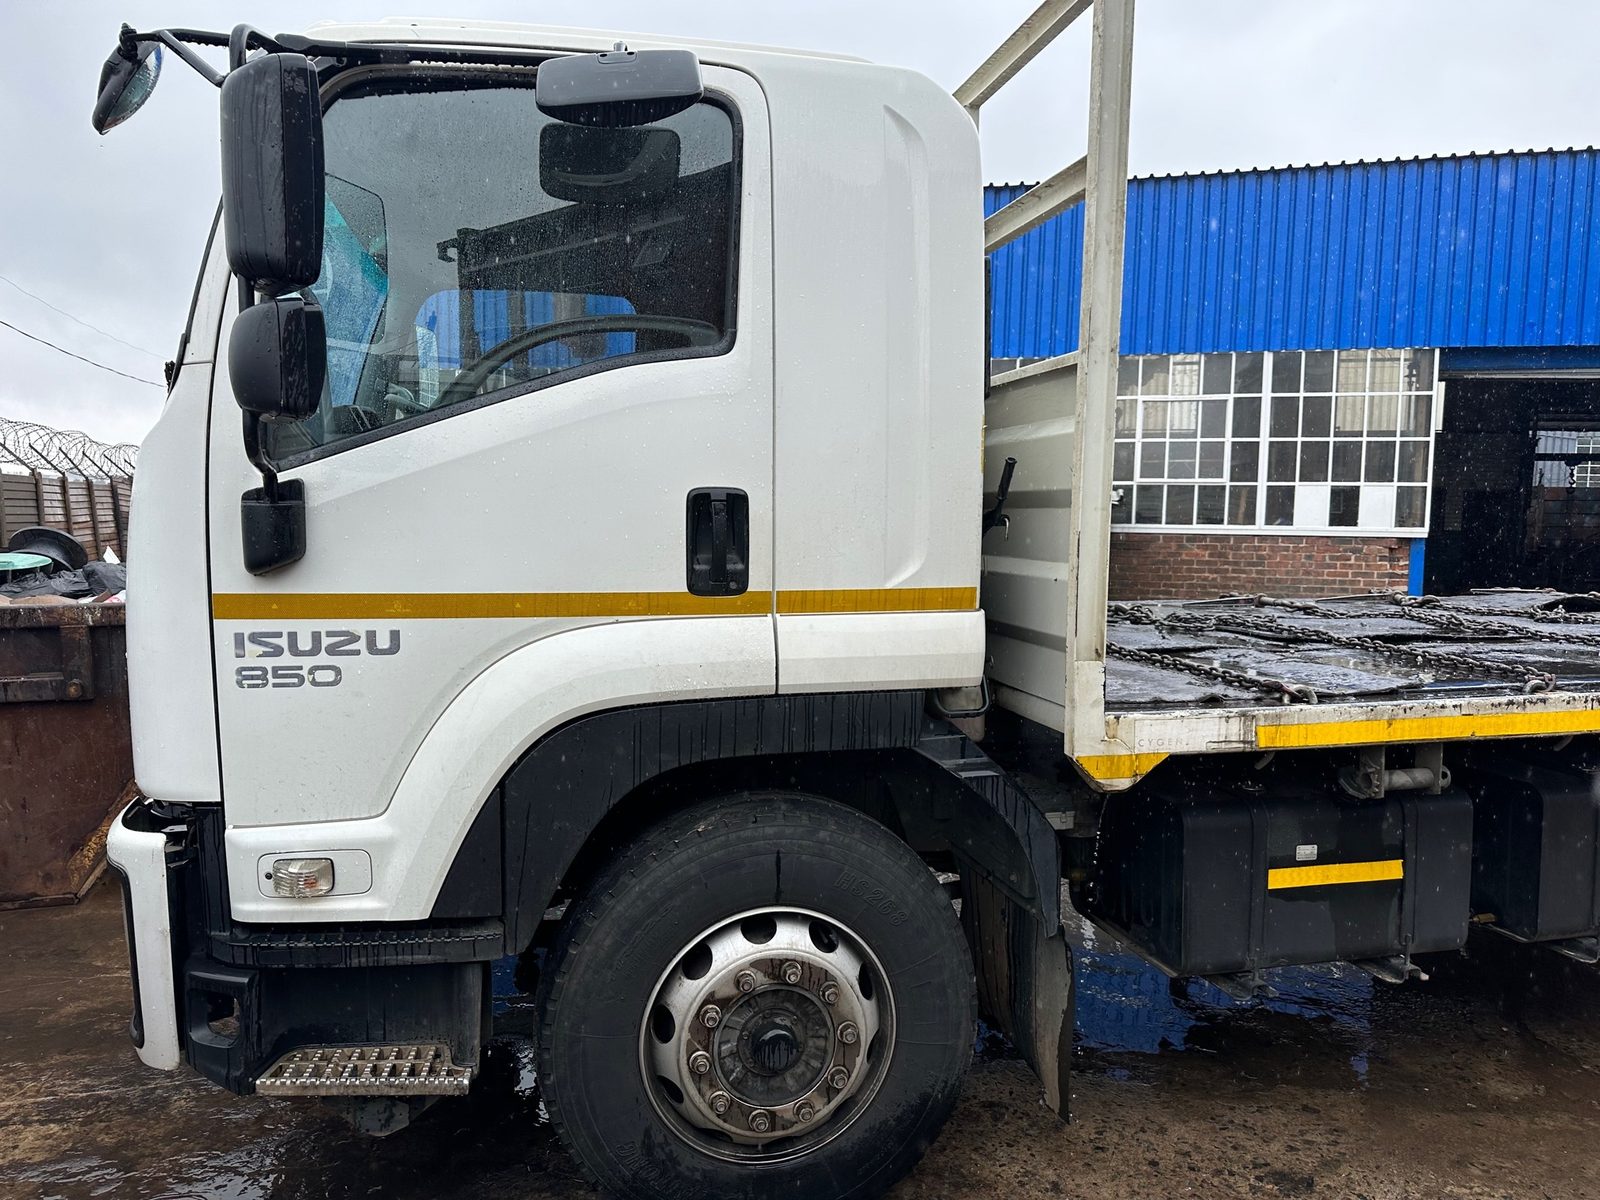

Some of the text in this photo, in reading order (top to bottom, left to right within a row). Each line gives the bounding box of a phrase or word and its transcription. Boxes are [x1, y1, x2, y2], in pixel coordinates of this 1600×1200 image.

[234, 629, 400, 658] ISUZU
[235, 664, 342, 688] 850
[832, 870, 907, 927] HS268
